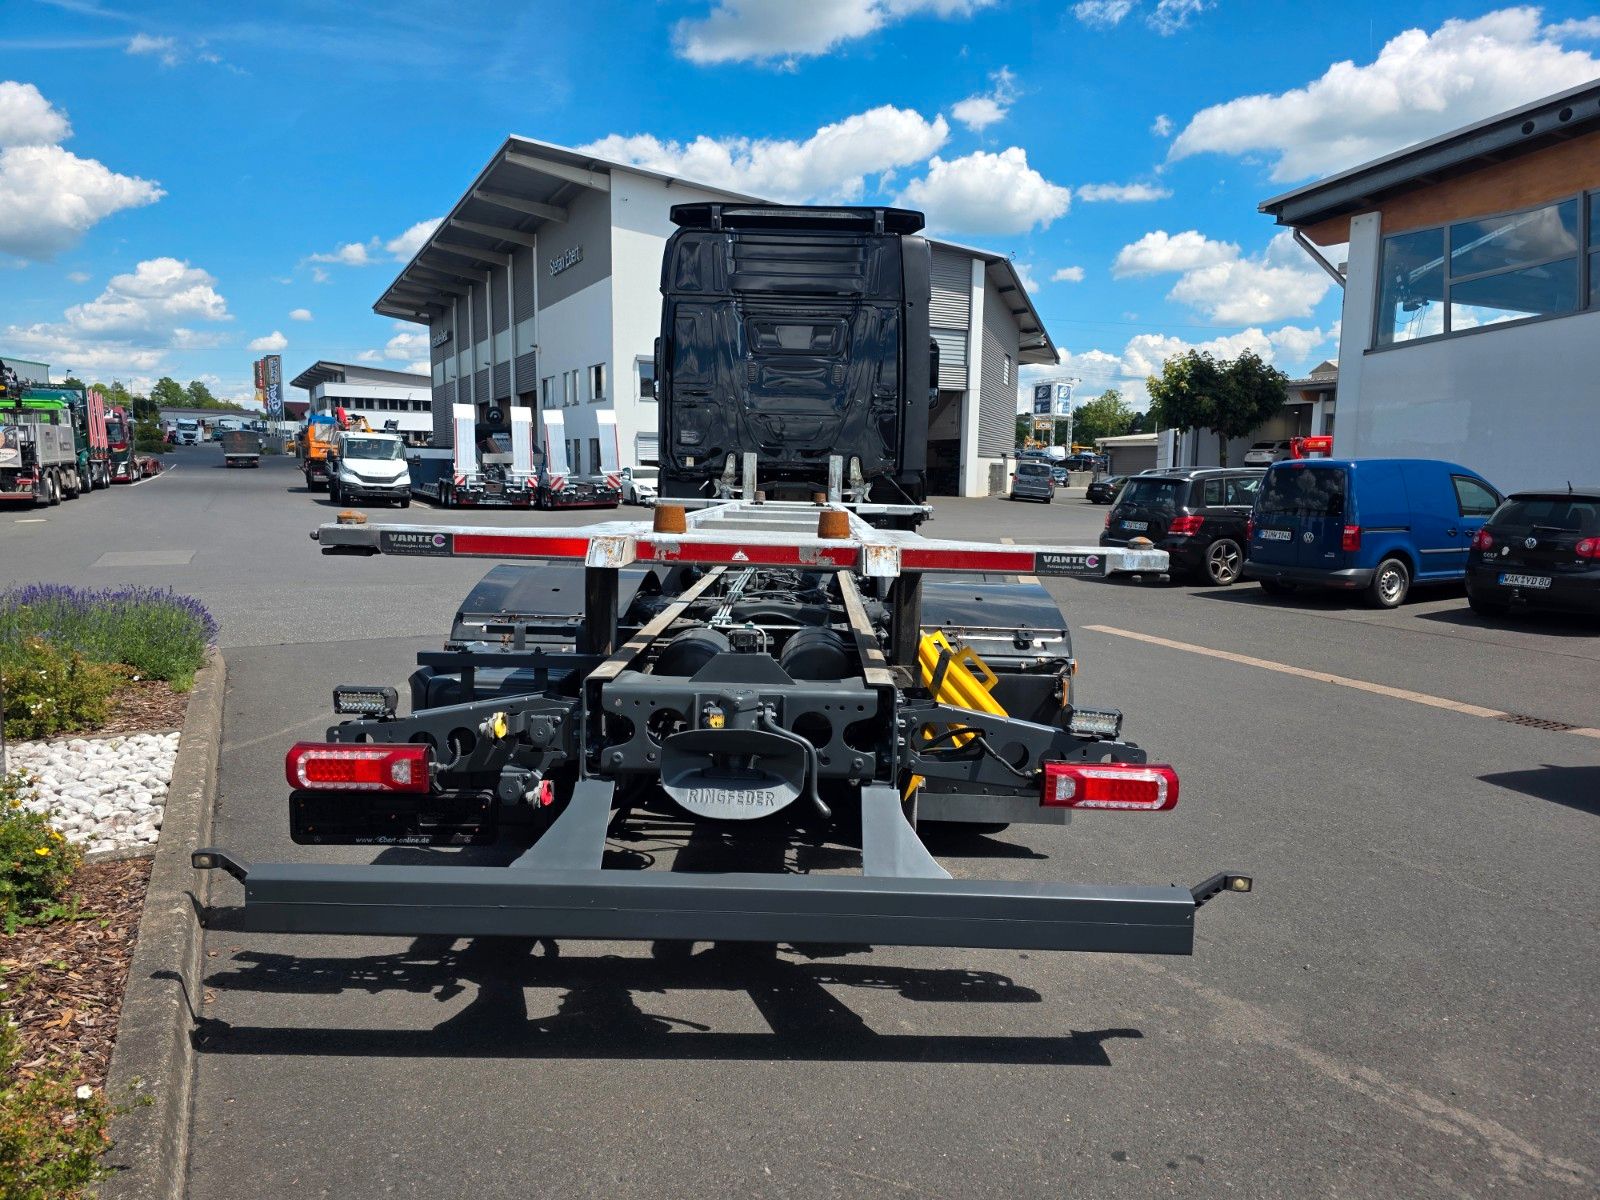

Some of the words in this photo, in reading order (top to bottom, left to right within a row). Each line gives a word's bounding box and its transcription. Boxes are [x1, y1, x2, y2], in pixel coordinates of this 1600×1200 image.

[566, 245, 580, 267] Ebert
[388, 533, 446, 548] VANTEC
[1043, 554, 1100, 569] VANTEC
[1504, 574, 1520, 584] WAK
[688, 788, 775, 806] RINGFEDER
